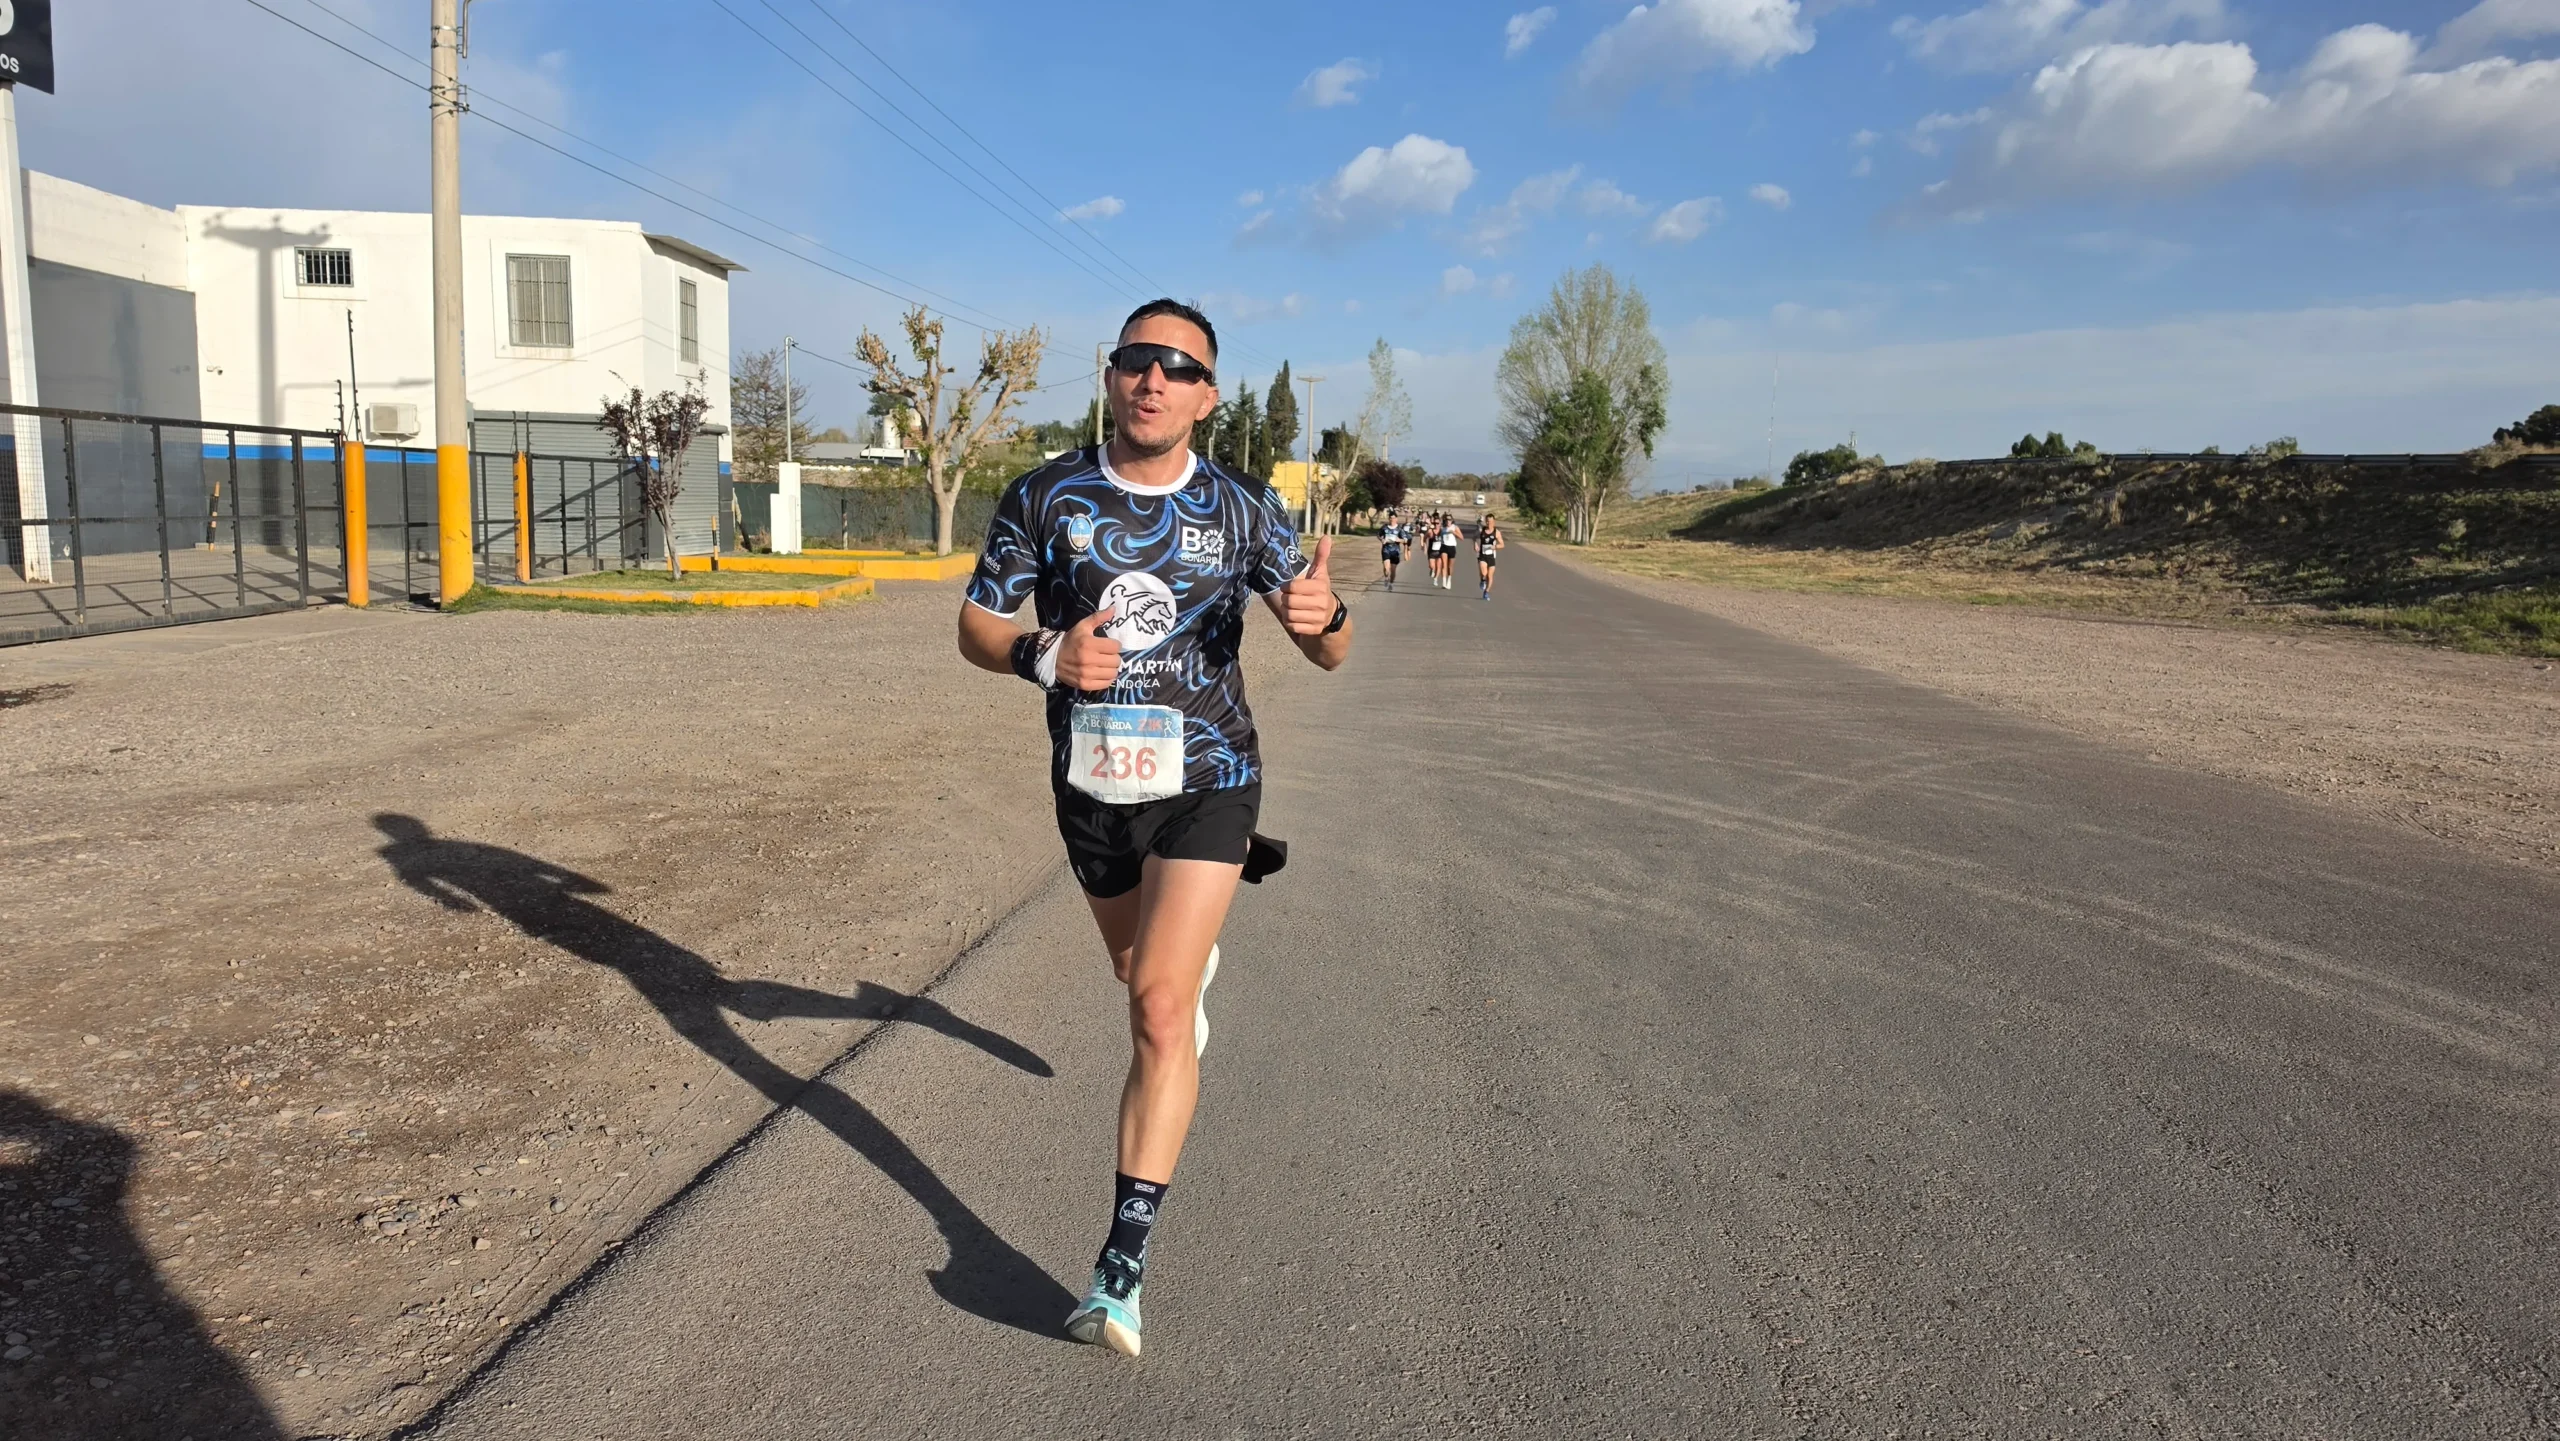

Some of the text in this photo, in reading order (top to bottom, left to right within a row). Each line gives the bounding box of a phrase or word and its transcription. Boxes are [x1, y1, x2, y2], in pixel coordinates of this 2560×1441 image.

[1109, 678, 1160, 689] ENDOZA
[1091, 719, 1132, 730] BONARDA
[1090, 744, 1157, 780] 236
